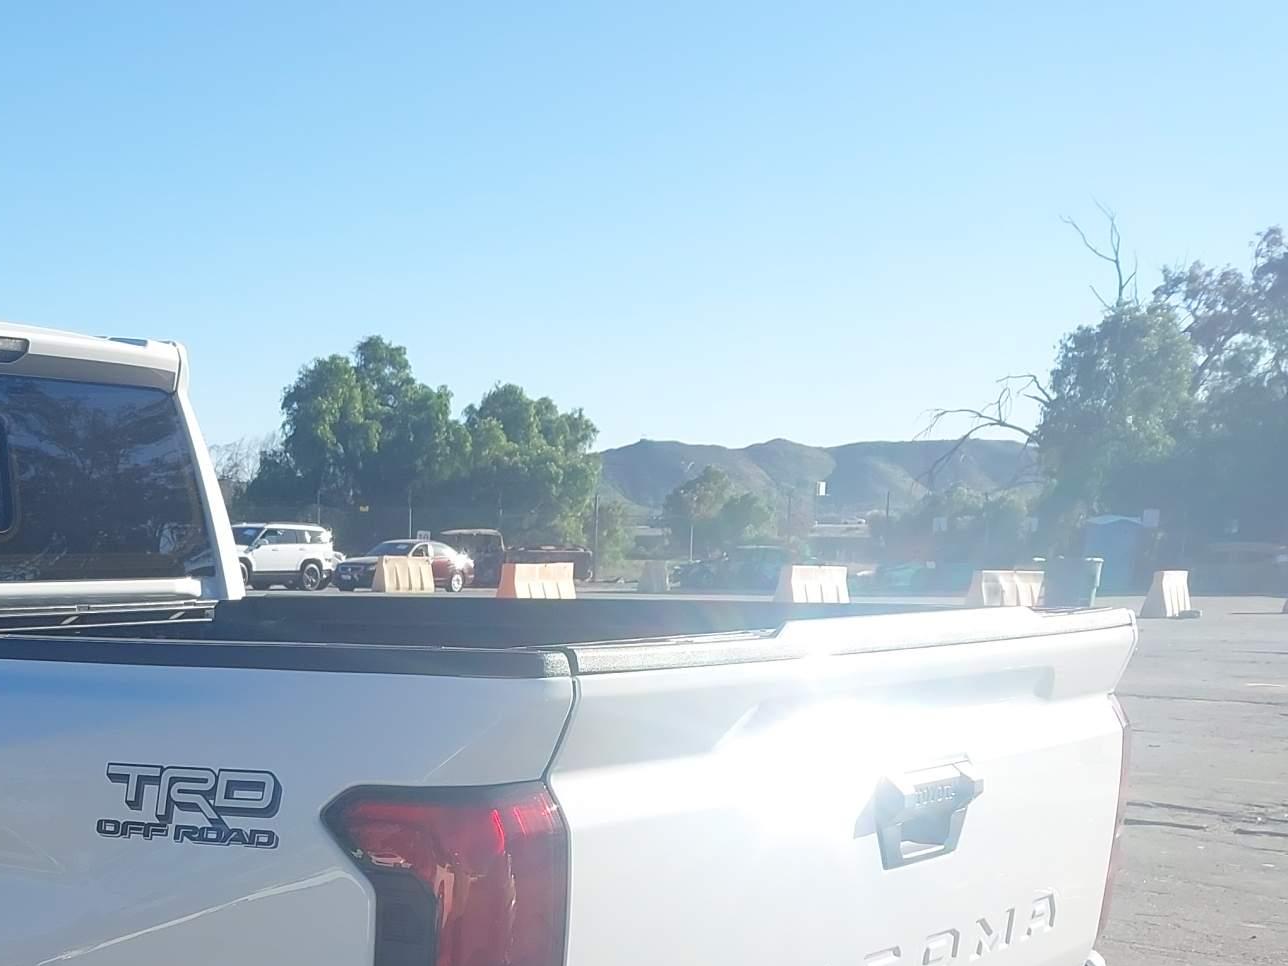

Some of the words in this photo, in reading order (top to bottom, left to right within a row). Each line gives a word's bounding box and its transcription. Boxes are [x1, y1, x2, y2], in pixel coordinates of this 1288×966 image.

[106, 762, 283, 826] TRD
[96, 818, 168, 841] OFF
[173, 824, 280, 850] ROAD
